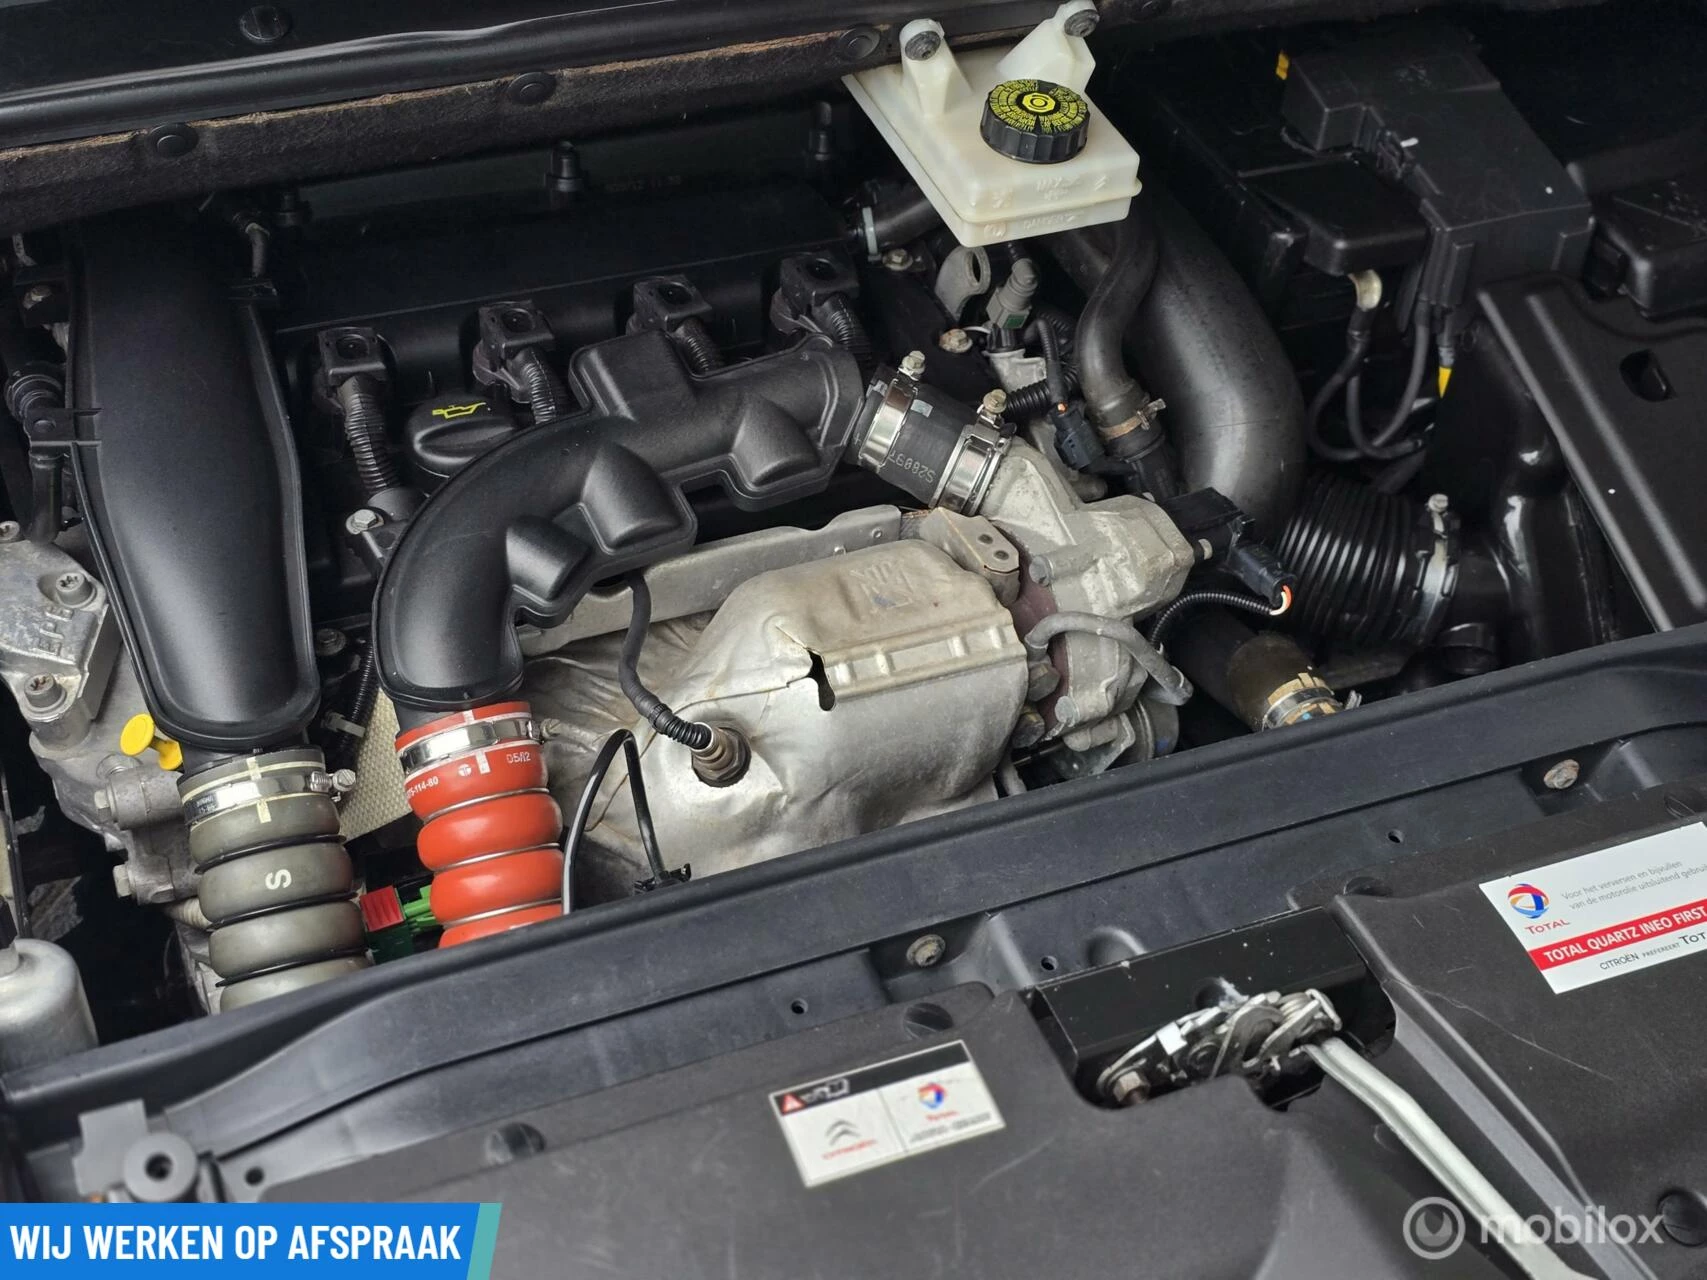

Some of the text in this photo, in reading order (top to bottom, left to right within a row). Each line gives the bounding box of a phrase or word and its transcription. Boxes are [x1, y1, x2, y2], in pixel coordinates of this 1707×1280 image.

[1561, 861, 1683, 900] Voor het verversen en bijvullen
[1570, 900, 1587, 910] van
[1586, 895, 1599, 905] de
[1598, 884, 1639, 901] motorolie
[1638, 871, 1681, 890] uitsluitend
[1543, 905, 1707, 964] TOTAL QUARTZ INEO FIRST
